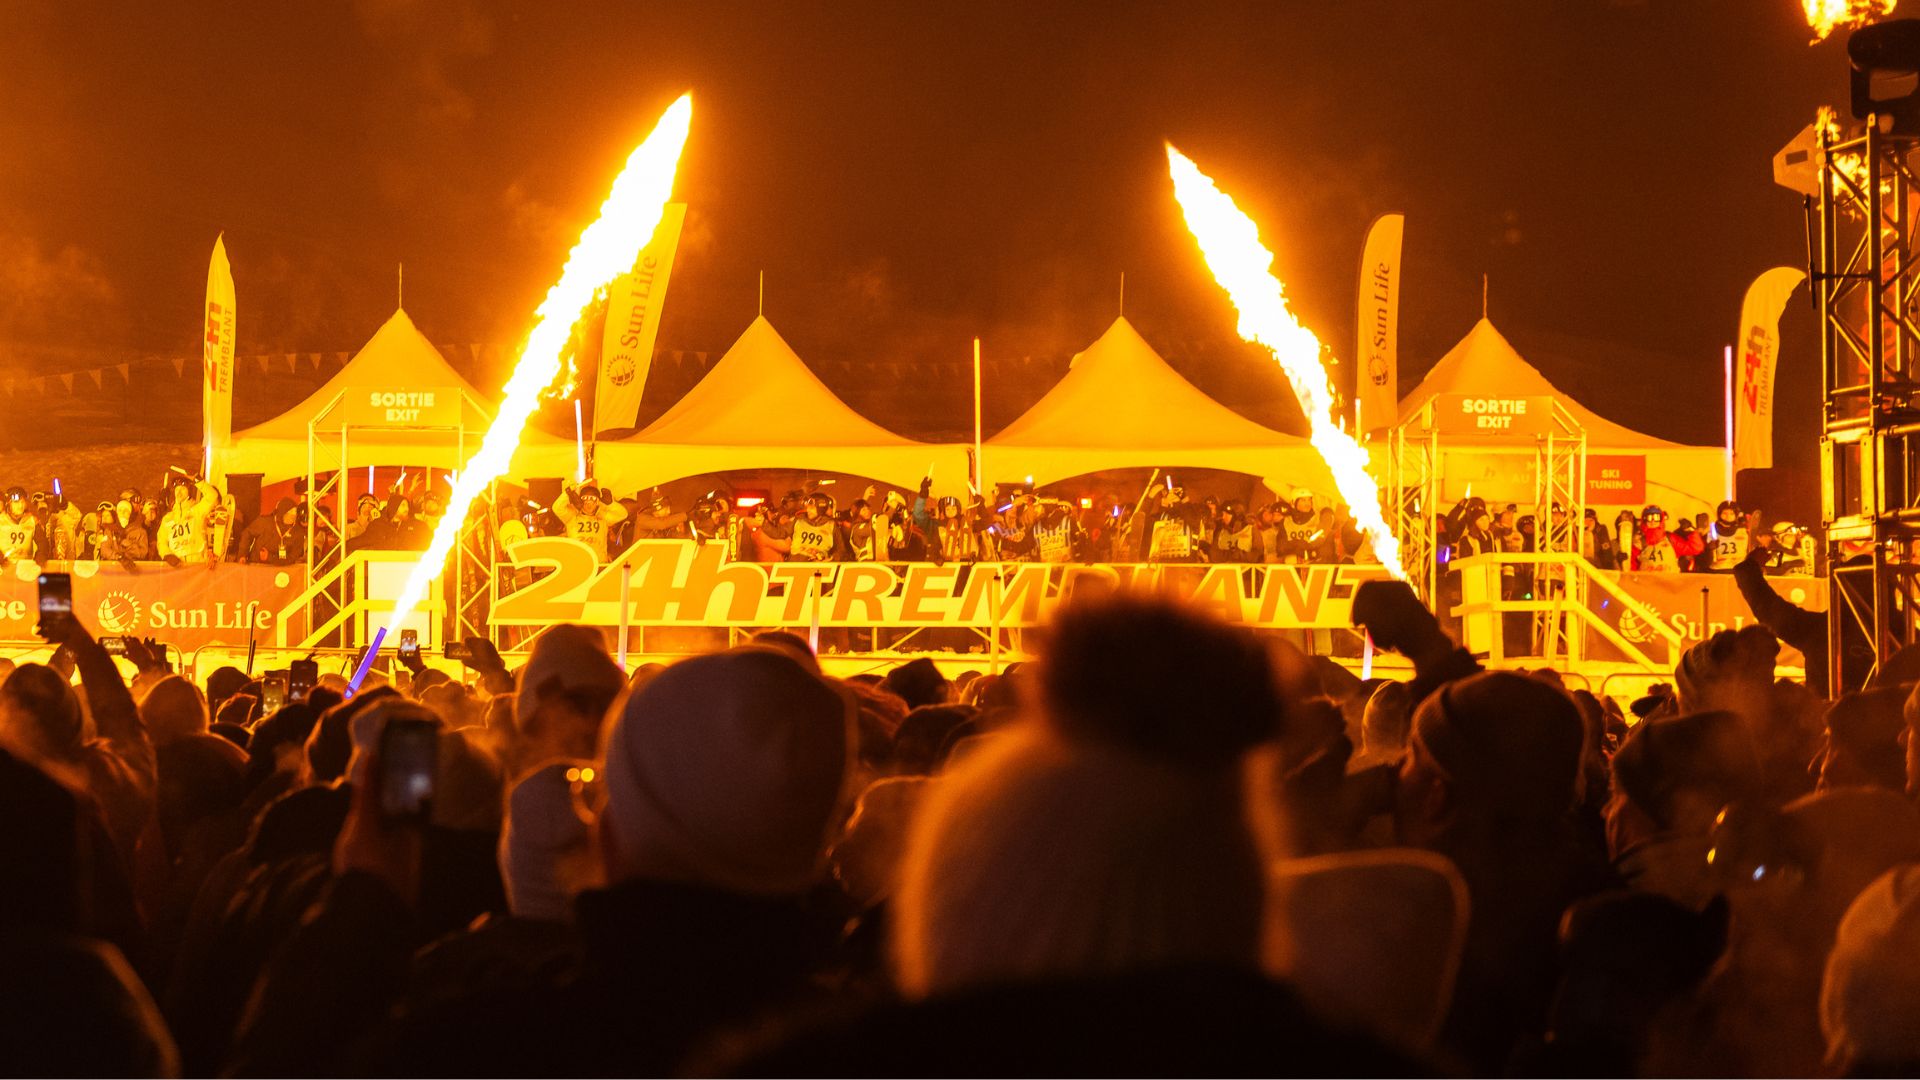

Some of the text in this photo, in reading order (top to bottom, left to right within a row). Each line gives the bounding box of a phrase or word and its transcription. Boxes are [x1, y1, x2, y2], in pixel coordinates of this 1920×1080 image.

[620, 255, 657, 350] Sun Life
[1374, 262, 1390, 350] Sun Life
[219, 307, 233, 393] TREMBLANT
[1744, 325, 1765, 415] 24h
[370, 392, 435, 407] SORTIE
[1462, 399, 1526, 414] SORTIE
[386, 408, 420, 422] EXIT
[1477, 415, 1512, 428] EXIT
[1601, 469, 1620, 479] SKI
[1589, 480, 1633, 490] TUNING
[172, 522, 191, 539] 201
[577, 521, 600, 534] 239
[10, 532, 25, 545] 99
[801, 531, 823, 546] 999
[1649, 549, 1663, 562] 41
[1721, 542, 1737, 555] 23
[769, 566, 1394, 624] TREMANT
[150, 600, 272, 630] Sun Life
